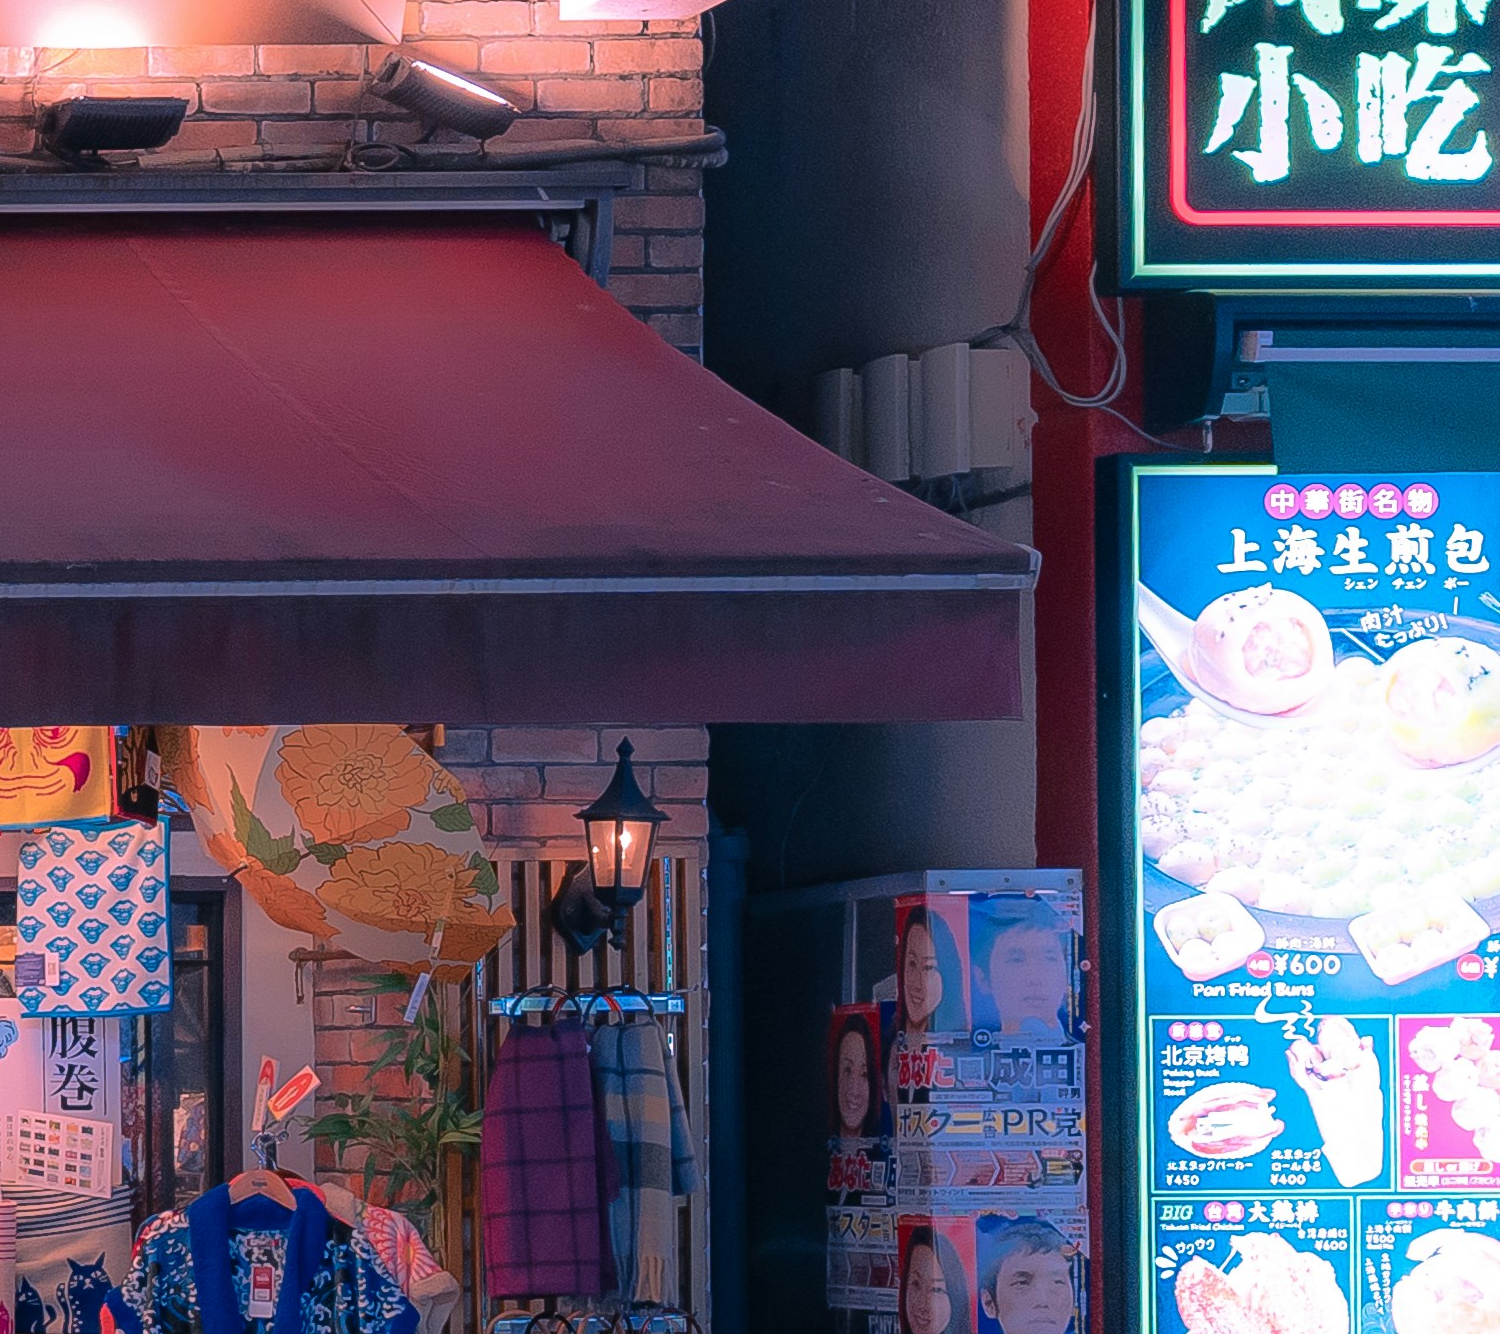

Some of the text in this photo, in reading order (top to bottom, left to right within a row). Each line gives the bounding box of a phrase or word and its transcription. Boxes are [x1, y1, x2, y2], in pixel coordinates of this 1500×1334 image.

[1202, 41, 1494, 185] 小吃
[1216, 522, 1490, 576] 上海生煎包
[49, 1017, 100, 1111] 腹巻
[1159, 1205, 1194, 1221] BIG
